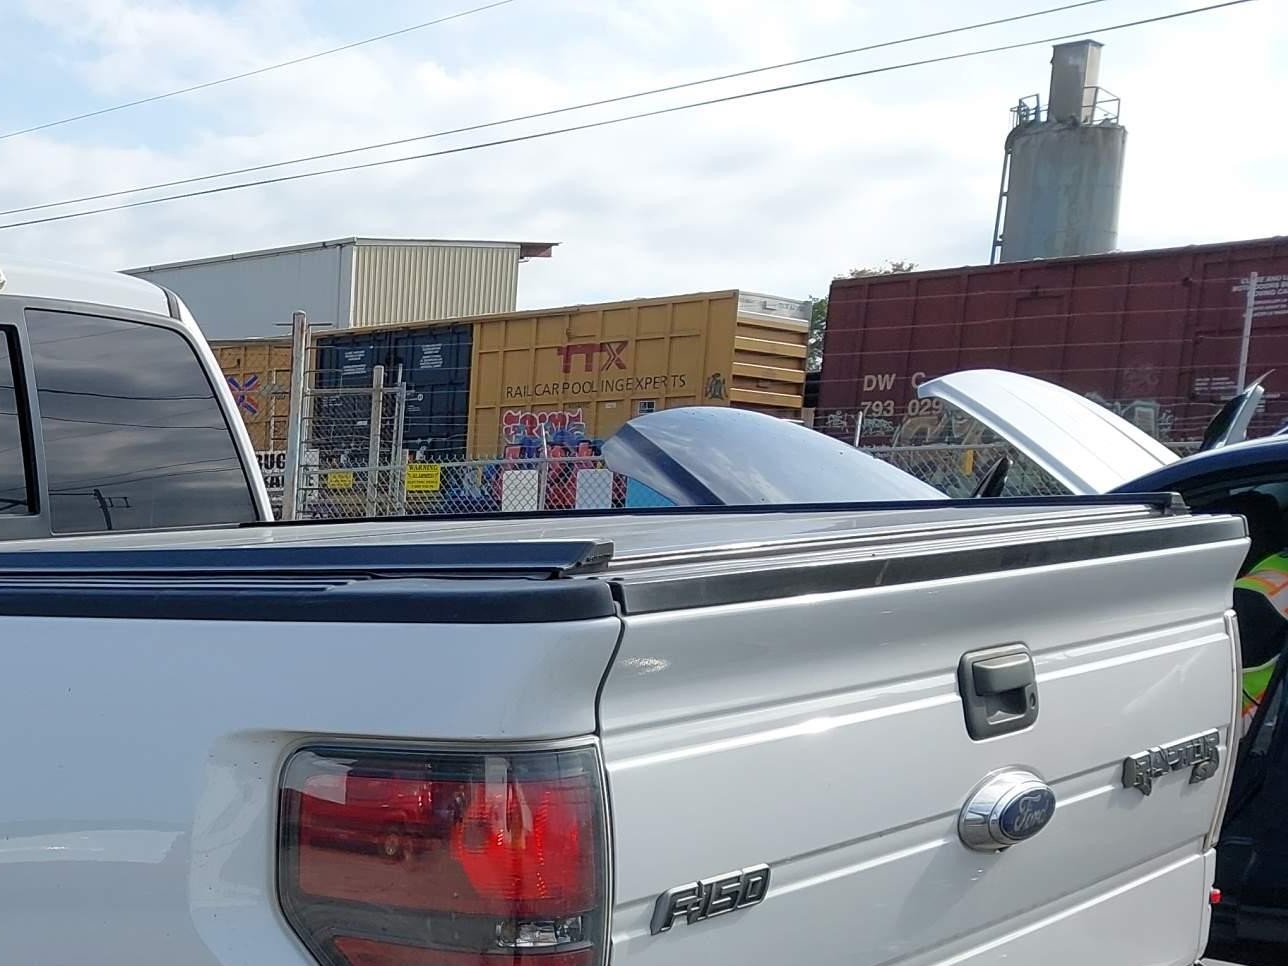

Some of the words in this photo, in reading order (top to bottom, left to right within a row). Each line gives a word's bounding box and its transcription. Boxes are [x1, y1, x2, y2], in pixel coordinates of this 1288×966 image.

[557, 340, 630, 375] TTX
[862, 400, 895, 417] 793
[908, 398, 944, 416] 029
[1014, 793, 1049, 832] Ford
